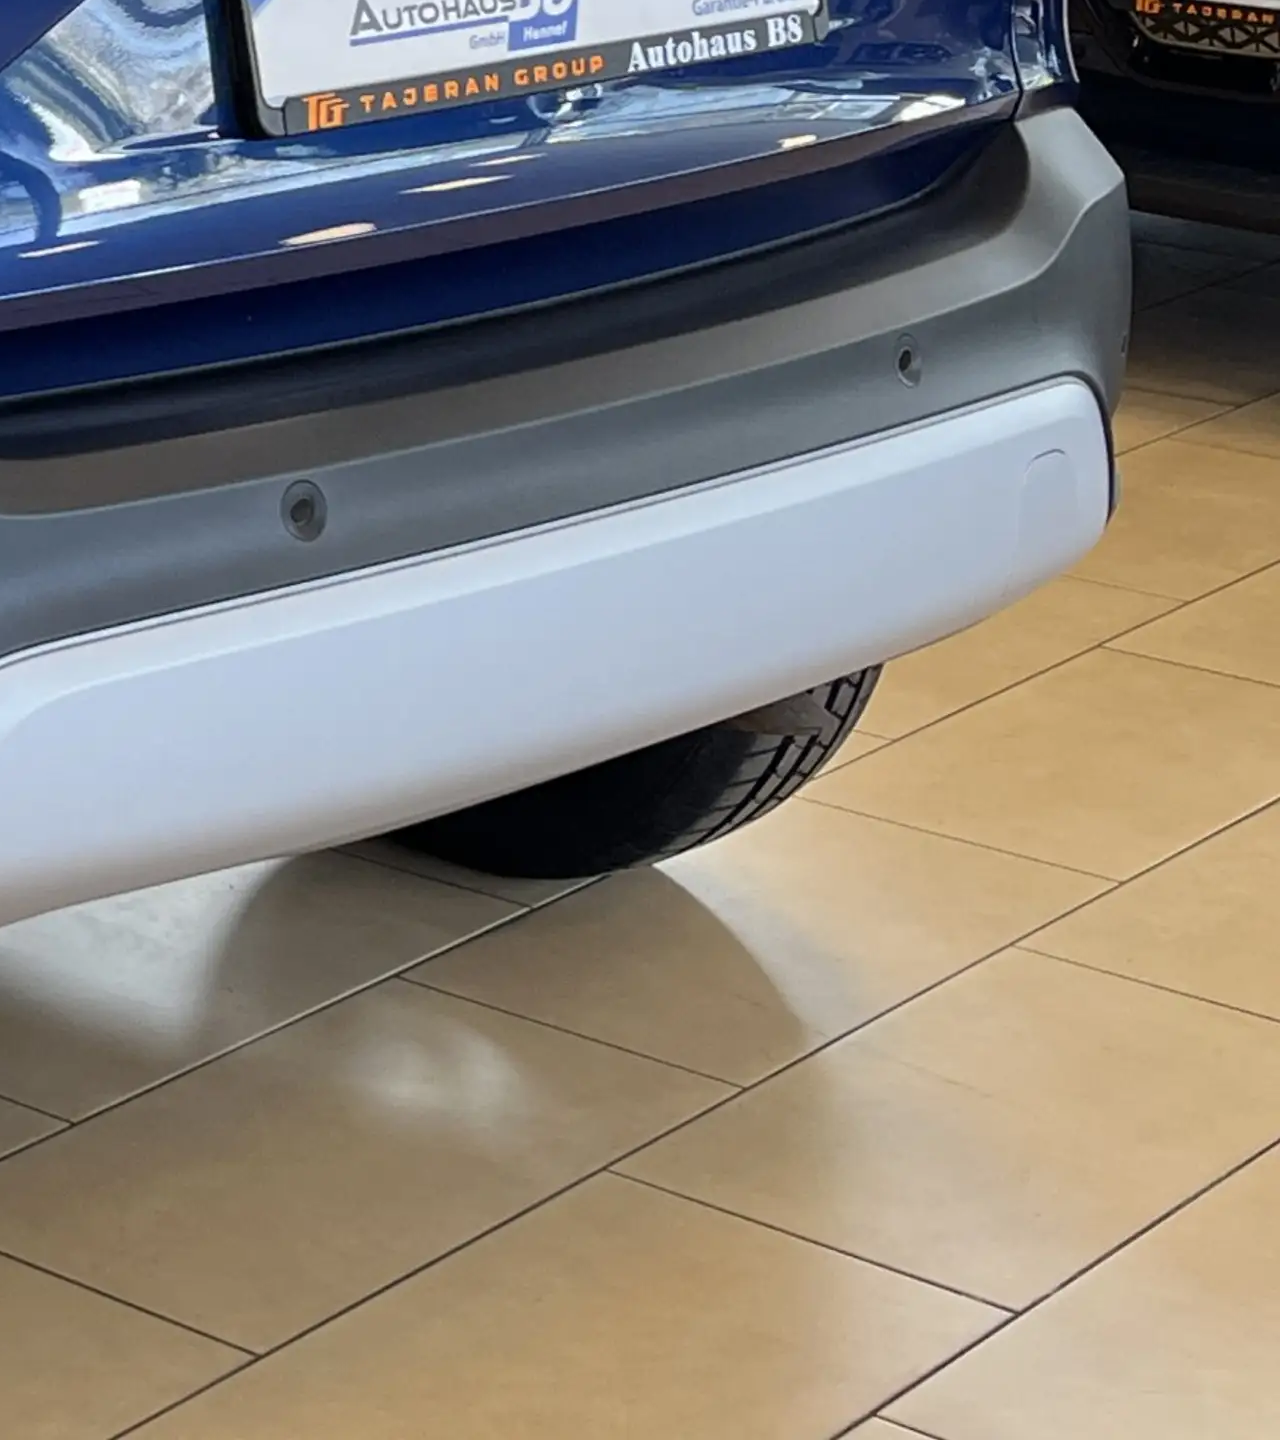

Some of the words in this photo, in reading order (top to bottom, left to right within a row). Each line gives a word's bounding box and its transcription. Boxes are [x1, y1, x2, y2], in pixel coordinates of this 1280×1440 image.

[469, 30, 506, 50] GmbH
[627, 29, 757, 73] Autohaus
[766, 14, 803, 47] B8
[360, 72, 499, 113] TAJERAN
[514, 55, 604, 86] GROUP
